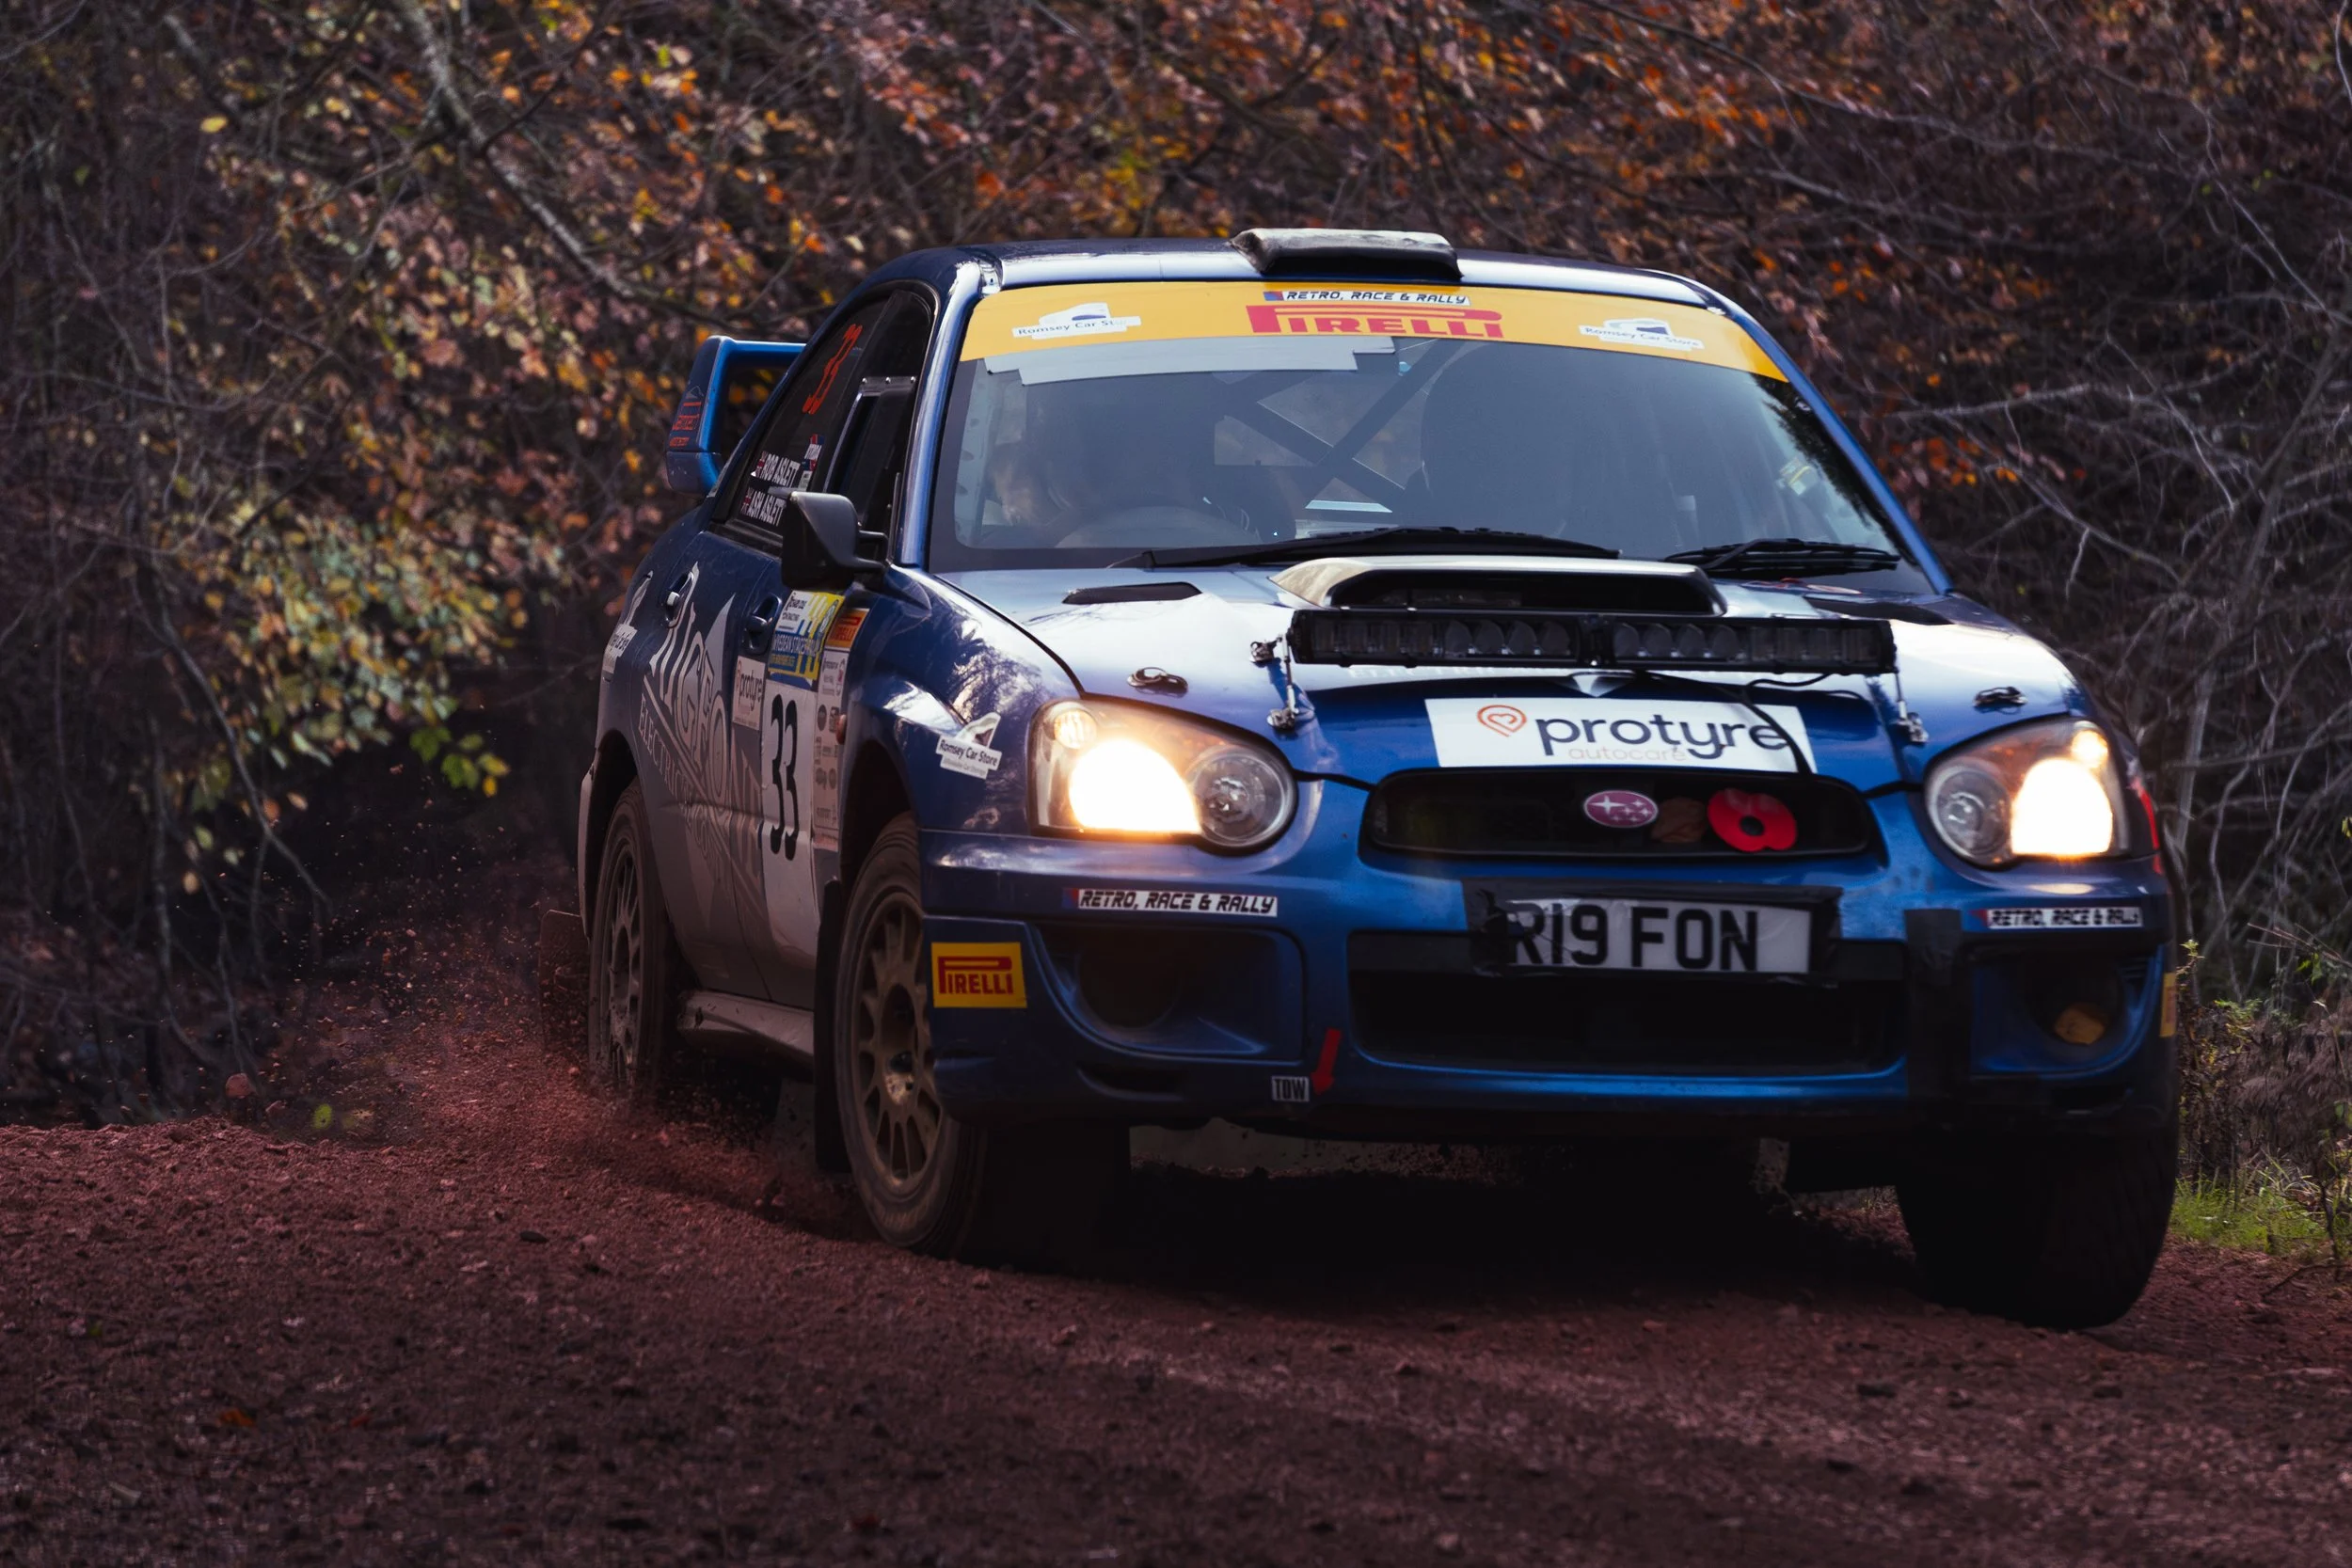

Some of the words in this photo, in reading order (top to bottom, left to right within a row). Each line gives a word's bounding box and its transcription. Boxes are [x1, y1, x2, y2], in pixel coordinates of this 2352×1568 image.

[1286, 292, 1343, 301] RETRO,
[1416, 294, 1466, 304] RALLY
[1018, 325, 1071, 335] Romsey
[1246, 305, 1504, 338] PIRELLI
[1584, 327, 1636, 339] Romsey
[1665, 337, 1700, 346] Store
[738, 669, 764, 711] protyre
[1535, 713, 1789, 760] protyre
[940, 739, 965, 759] Romsey
[965, 747, 977, 760] Car
[978, 751, 998, 767] Store
[1568, 745, 1687, 763] autocare
[771, 693, 799, 862] 33
[1079, 891, 1138, 911] RETRO,
[1144, 892, 1193, 911] RACE
[1199, 895, 1211, 911] &
[1216, 895, 1275, 914] RALLY
[2052, 910, 2090, 926] RACE
[1630, 907, 1758, 972] FON
[937, 956, 1014, 995] PIRELLI
[1274, 1079, 1308, 1101] TOW
